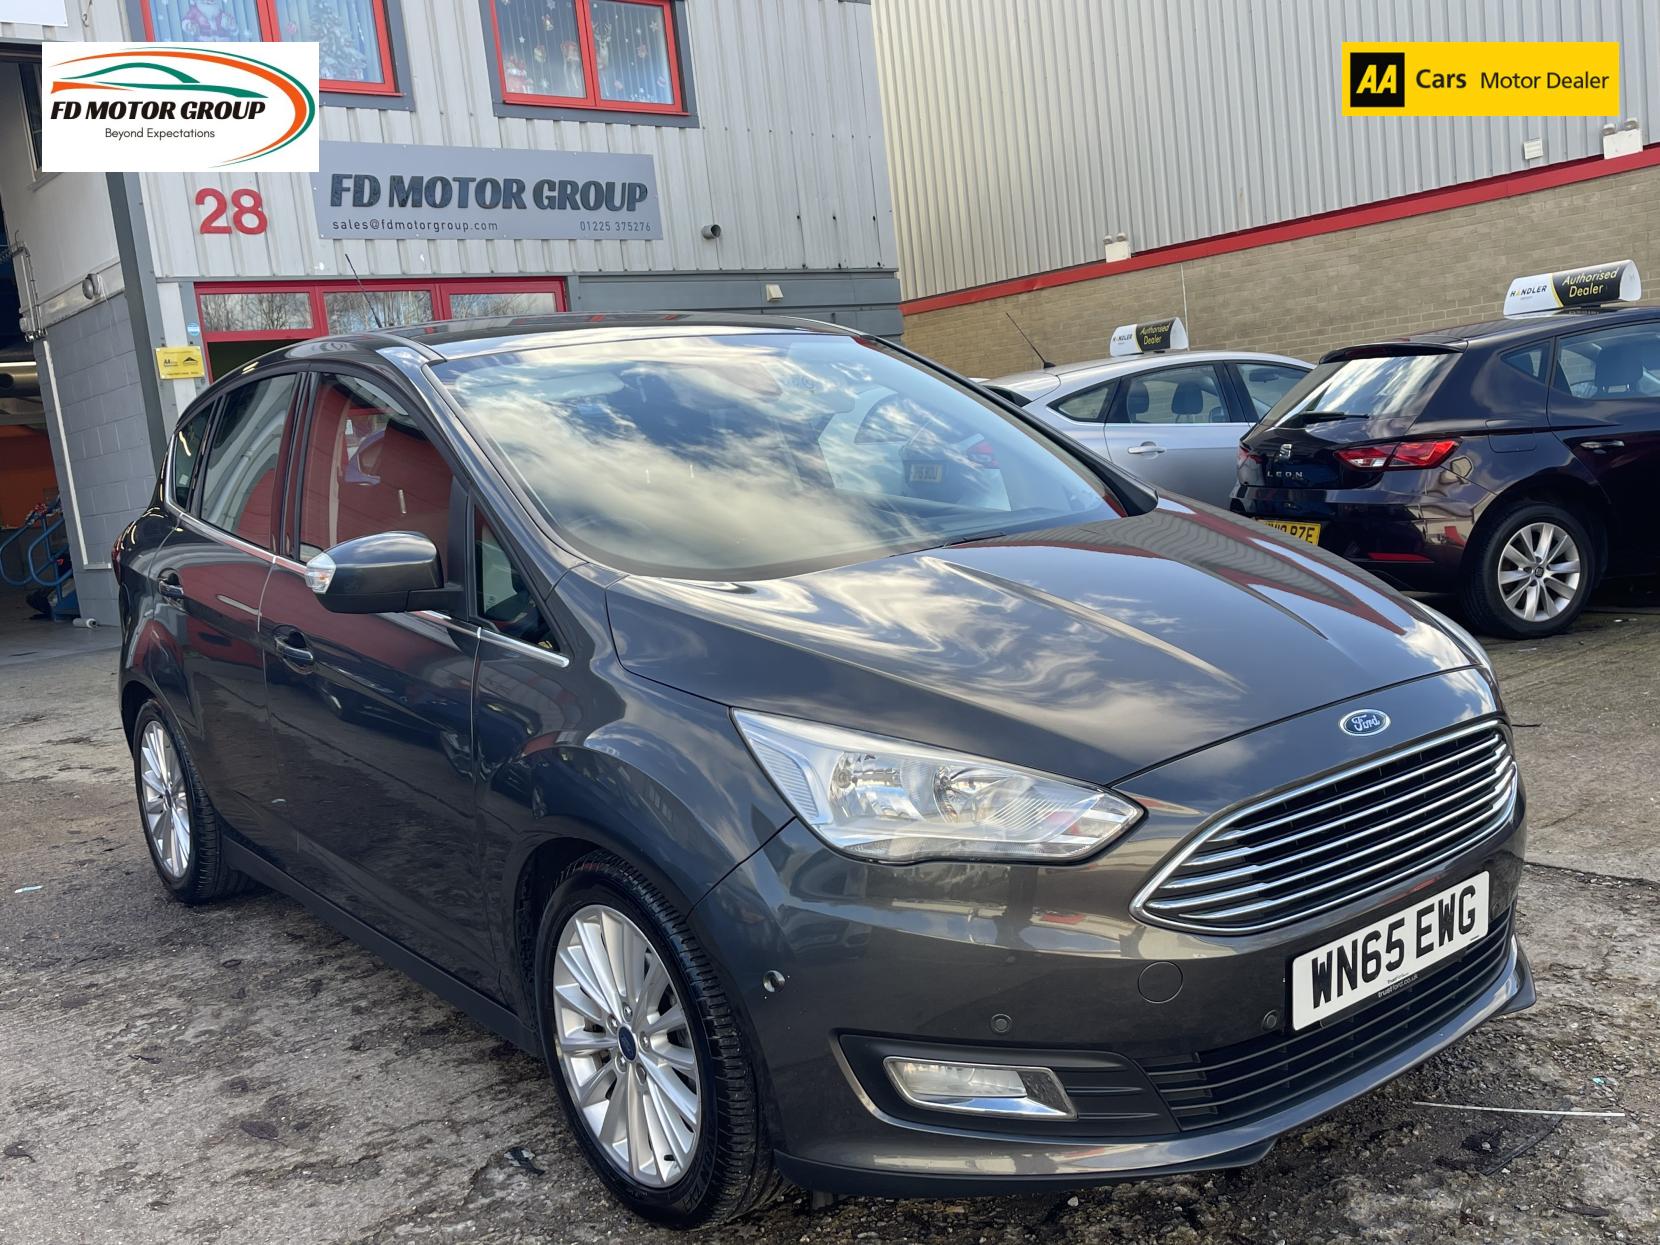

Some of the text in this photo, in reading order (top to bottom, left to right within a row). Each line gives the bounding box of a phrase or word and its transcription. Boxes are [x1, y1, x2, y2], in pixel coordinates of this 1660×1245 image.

[330, 173, 648, 212] FD MOTOR GROUP
[195, 187, 268, 235] 28
[332, 218, 651, 233] sales@fdmotorgroup.com 01225 375276
[1562, 267, 1620, 286] Authorised
[1569, 282, 1604, 298] Dealer
[1143, 335, 1162, 345] Dealer
[1351, 714, 1381, 731] Ford
[1311, 884, 1477, 1010] WN65 EWG
